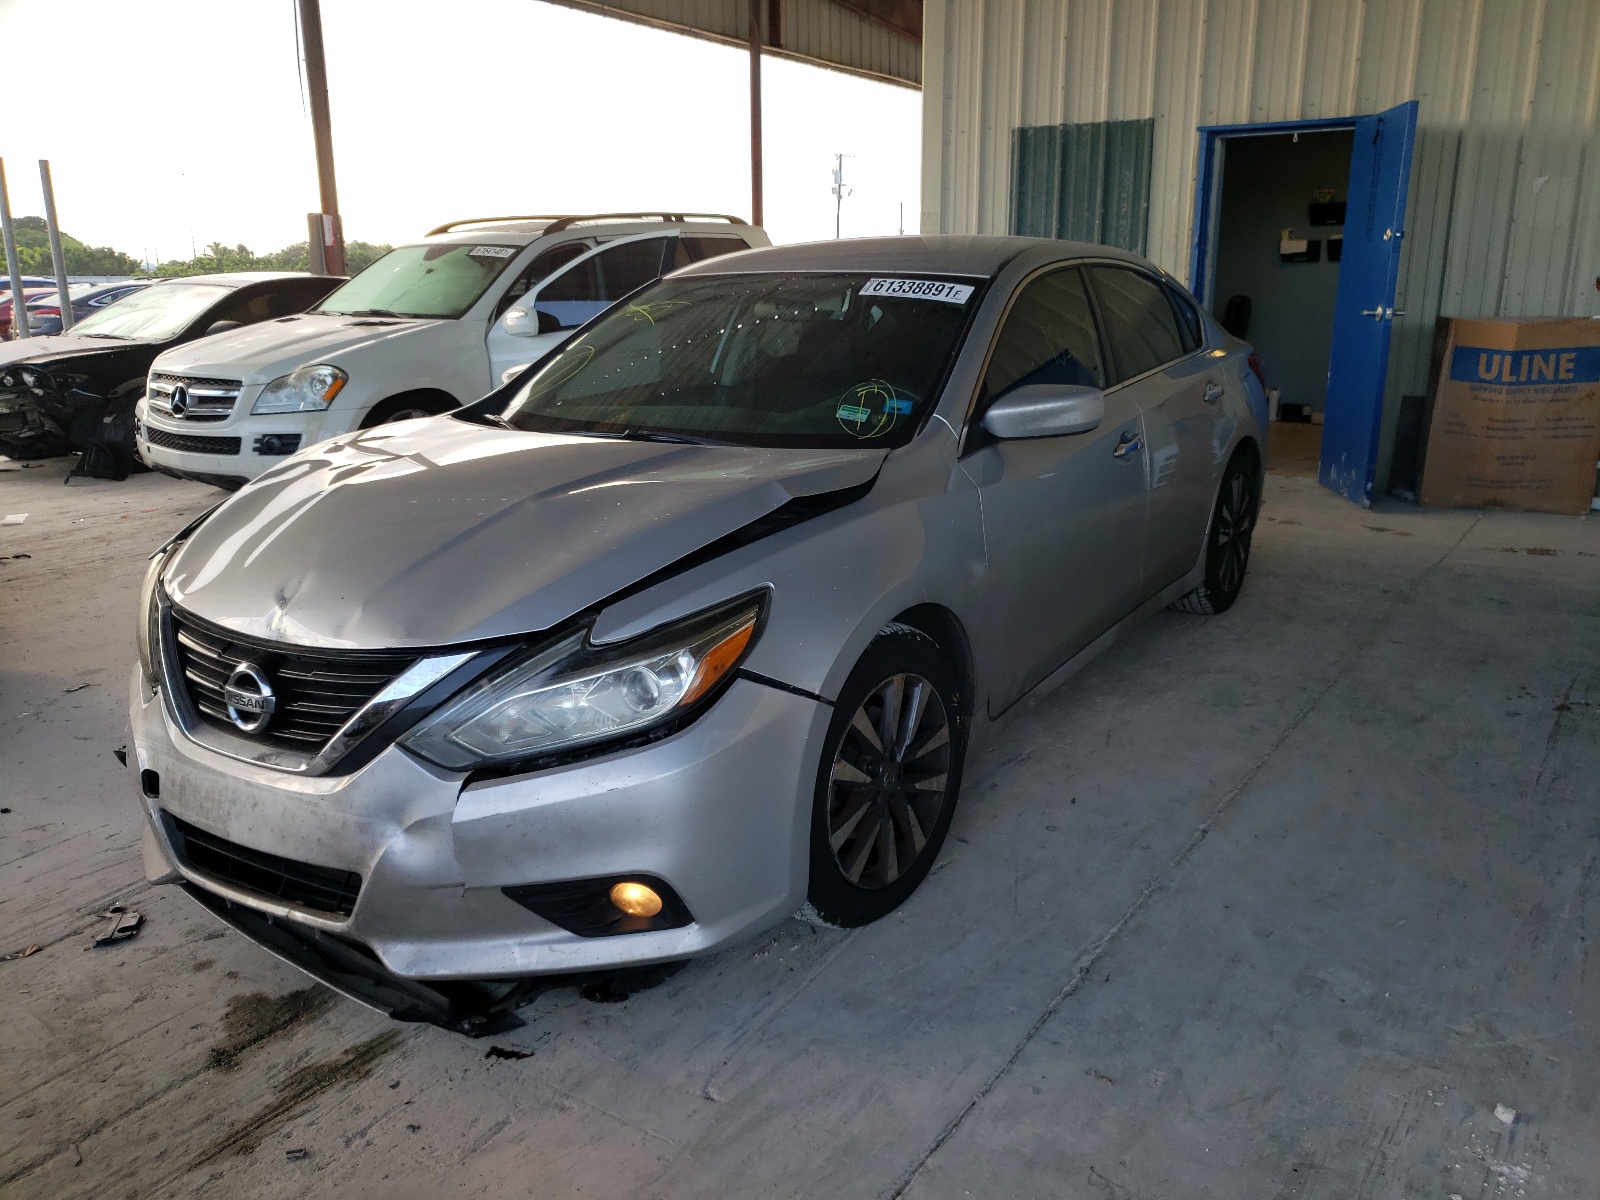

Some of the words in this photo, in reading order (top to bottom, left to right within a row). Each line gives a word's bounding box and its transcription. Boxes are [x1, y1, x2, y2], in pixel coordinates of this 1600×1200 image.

[873, 280, 956, 298] 61338891
[1478, 352, 1577, 382] ULINE
[227, 690, 265, 709] NISSAN
